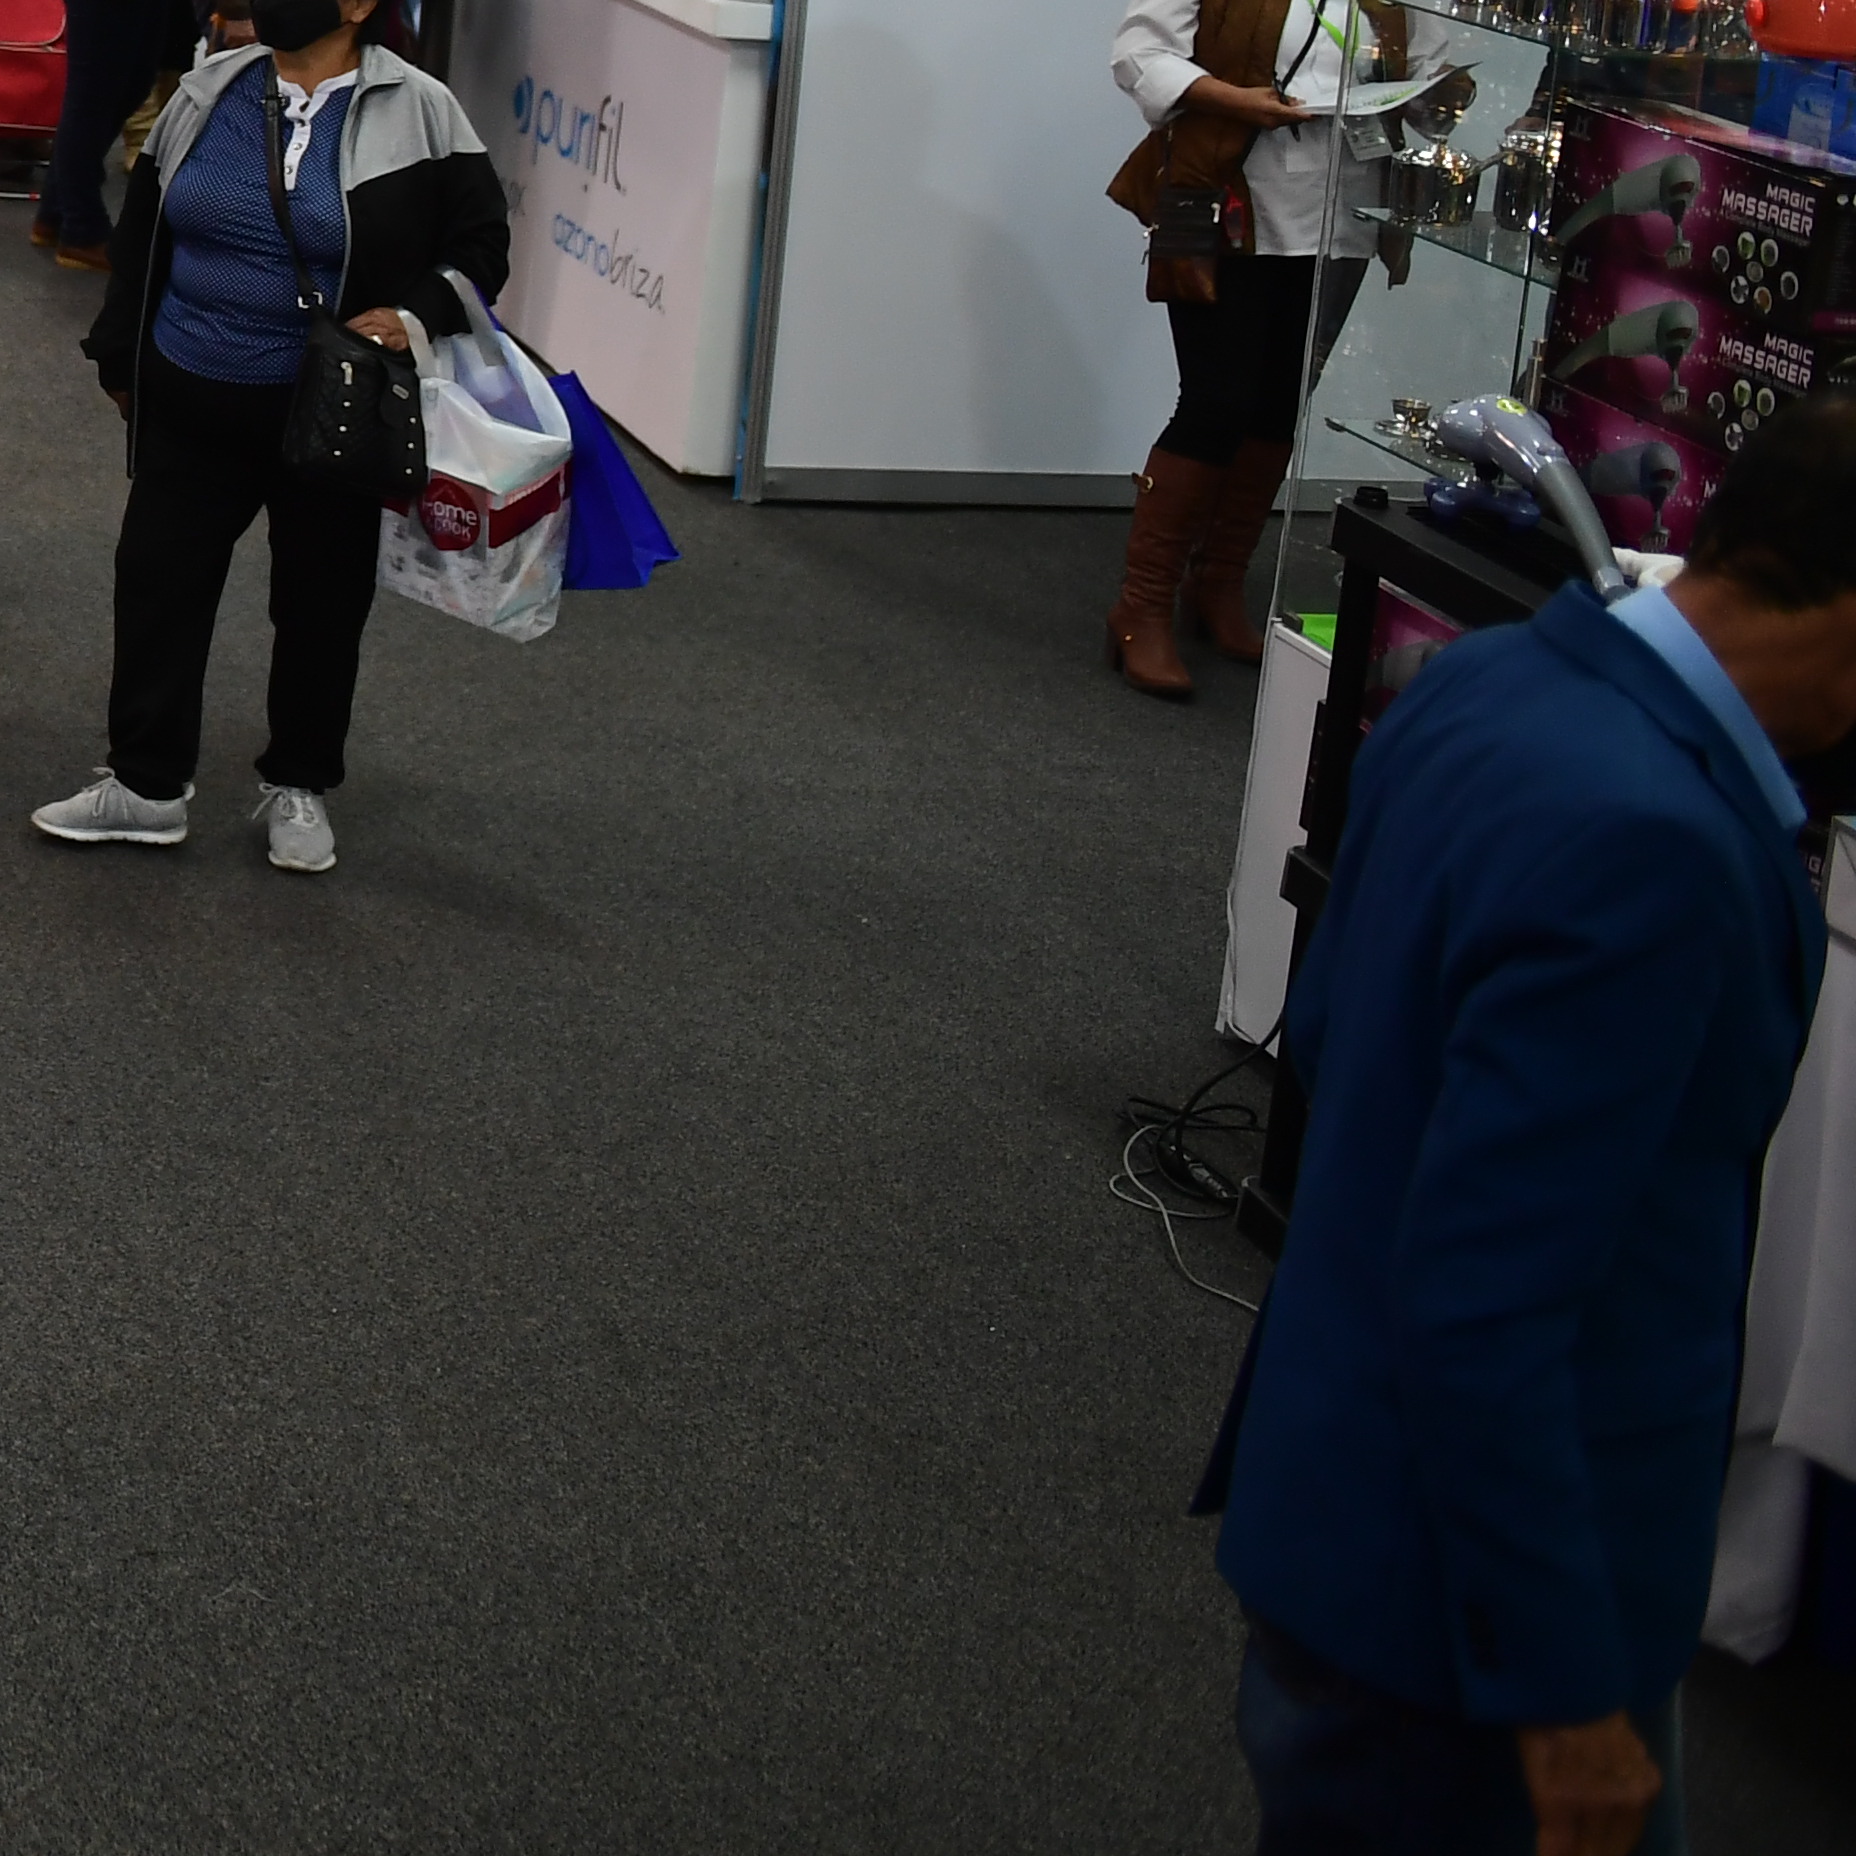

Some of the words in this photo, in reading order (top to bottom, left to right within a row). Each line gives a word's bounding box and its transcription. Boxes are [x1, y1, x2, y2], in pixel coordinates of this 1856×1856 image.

[1721, 188, 1813, 237] MASSAGER
[1766, 182, 1816, 214] MAGIC
[1719, 335, 1811, 389] MASSAGER
[1764, 332, 1814, 366] MAGIC
